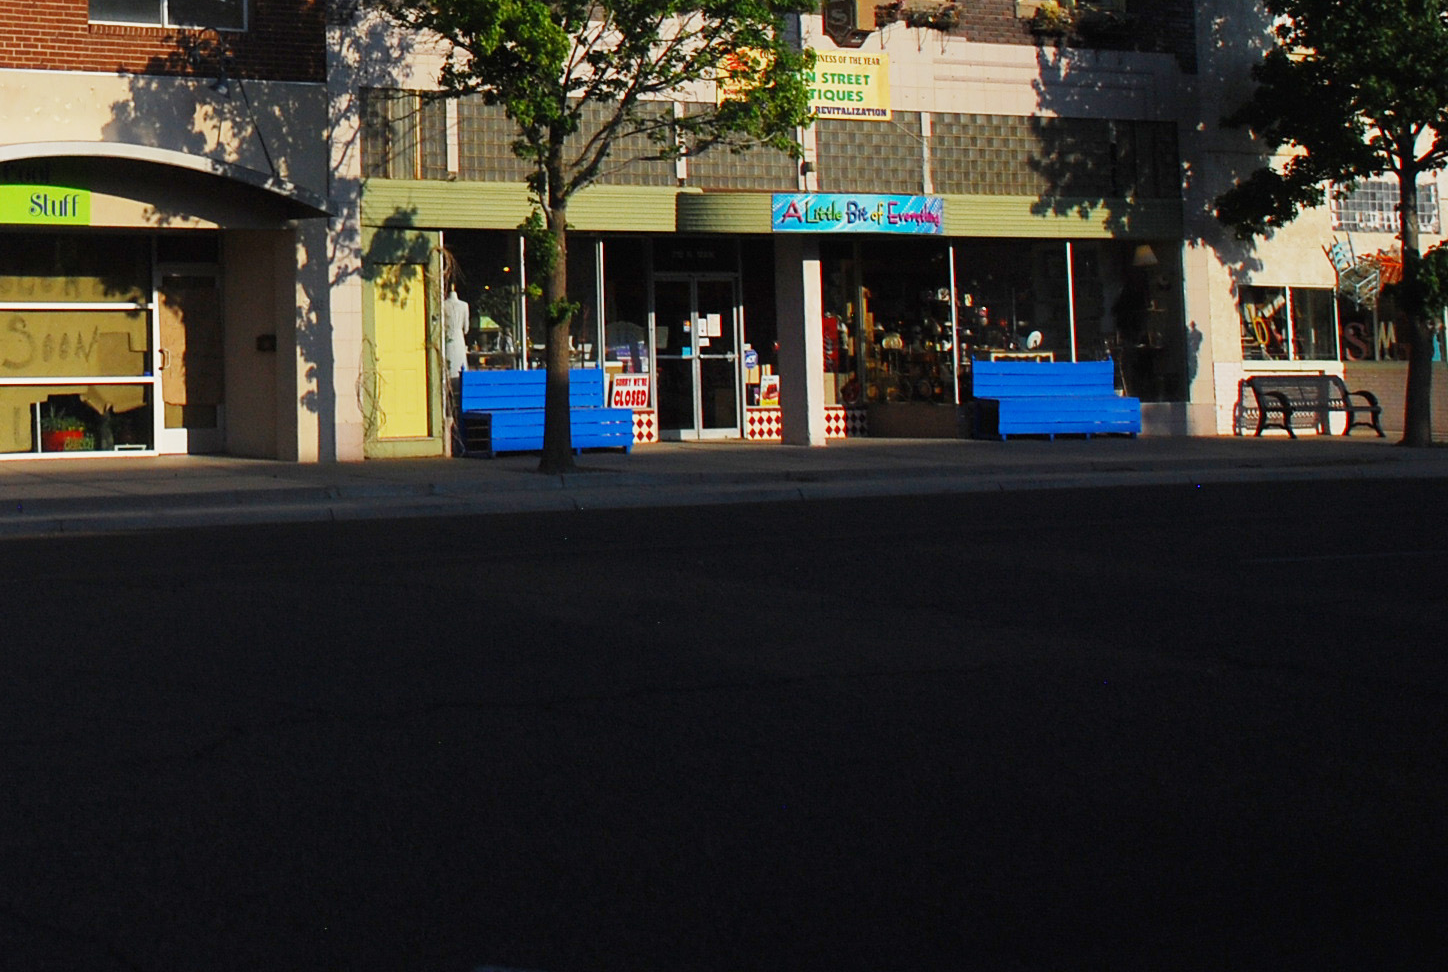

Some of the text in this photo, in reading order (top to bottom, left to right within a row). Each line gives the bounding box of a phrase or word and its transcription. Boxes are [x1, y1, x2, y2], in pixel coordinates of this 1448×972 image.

[838, 55, 848, 64] OF
[849, 56, 862, 65] THE
[863, 57, 881, 66] YEAR
[821, 72, 871, 86] STREET
[808, 88, 865, 103] TIQUES
[815, 106, 888, 117] REVITALIZATION
[28, 192, 81, 218] Stuff
[781, 200, 941, 227] A Little Bit of Everything
[613, 389, 647, 407] CLOSED
